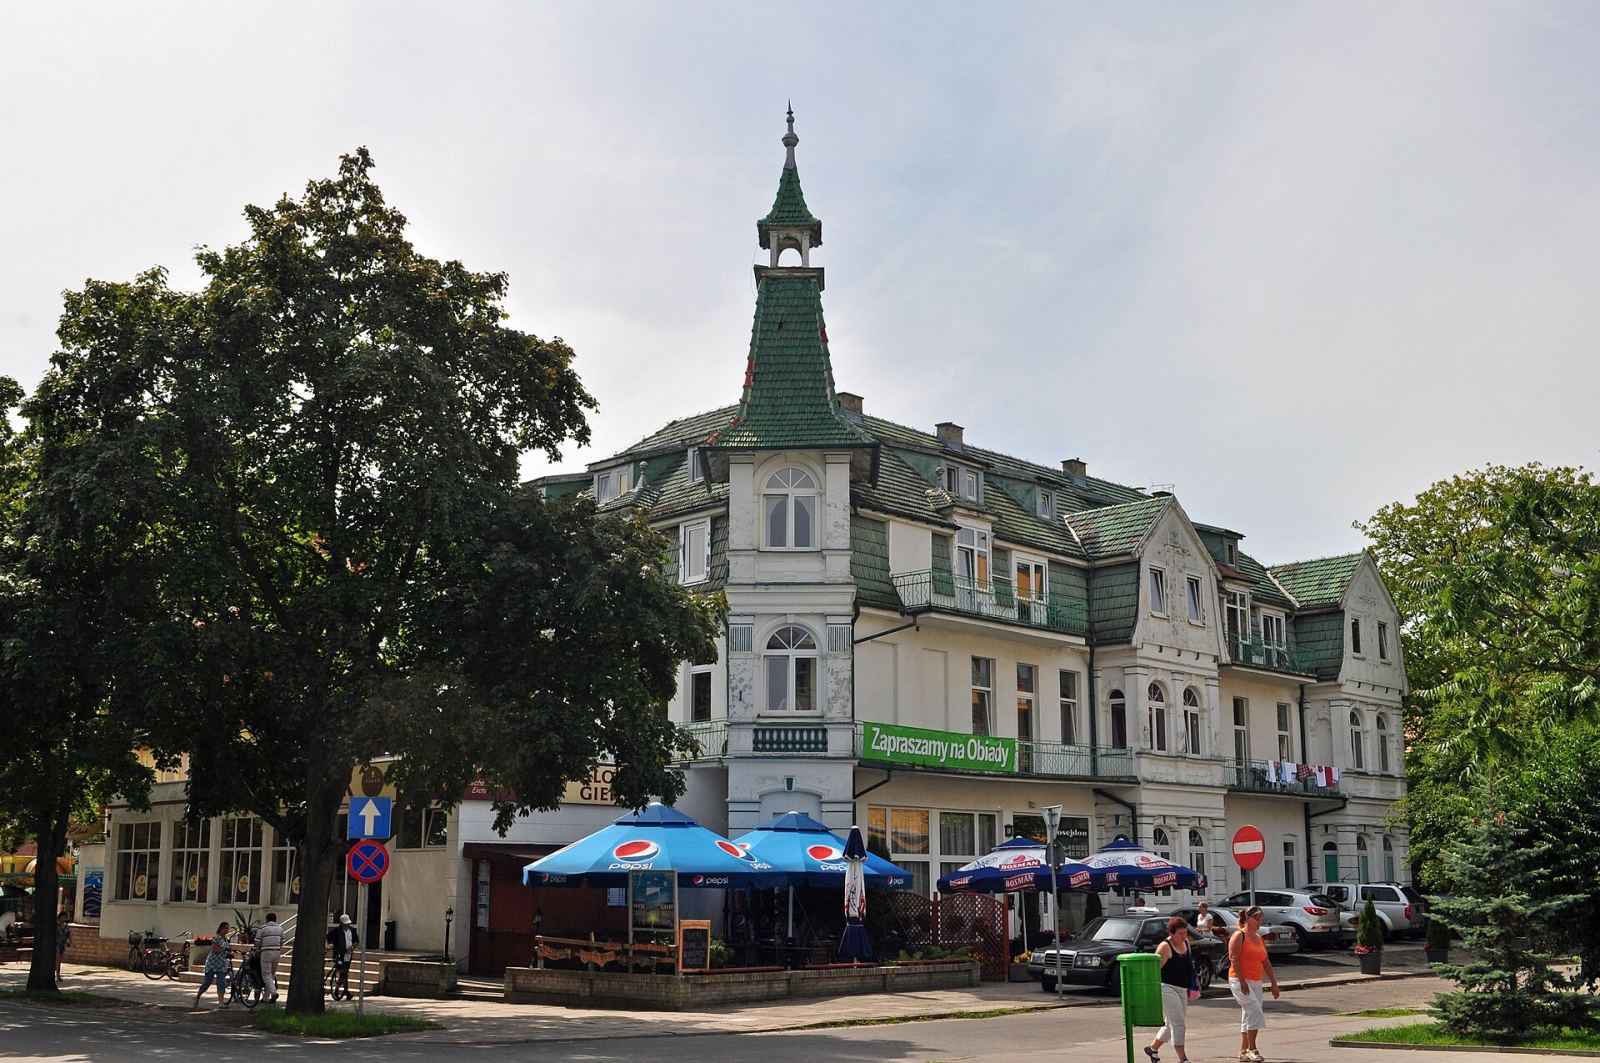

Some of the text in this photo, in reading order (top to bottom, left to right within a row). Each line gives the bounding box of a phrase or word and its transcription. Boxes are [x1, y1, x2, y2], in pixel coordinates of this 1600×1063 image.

[871, 727, 1009, 767] Zapraszamy na Obiady
[1057, 829, 1087, 838] osejdon
[608, 862, 653, 871] pepsi
[1001, 860, 1039, 869] BOSMAN
[706, 877, 729, 885] pepsi
[1005, 875, 1034, 888] BOSMAN
[1153, 872, 1177, 885] BOSMAN
